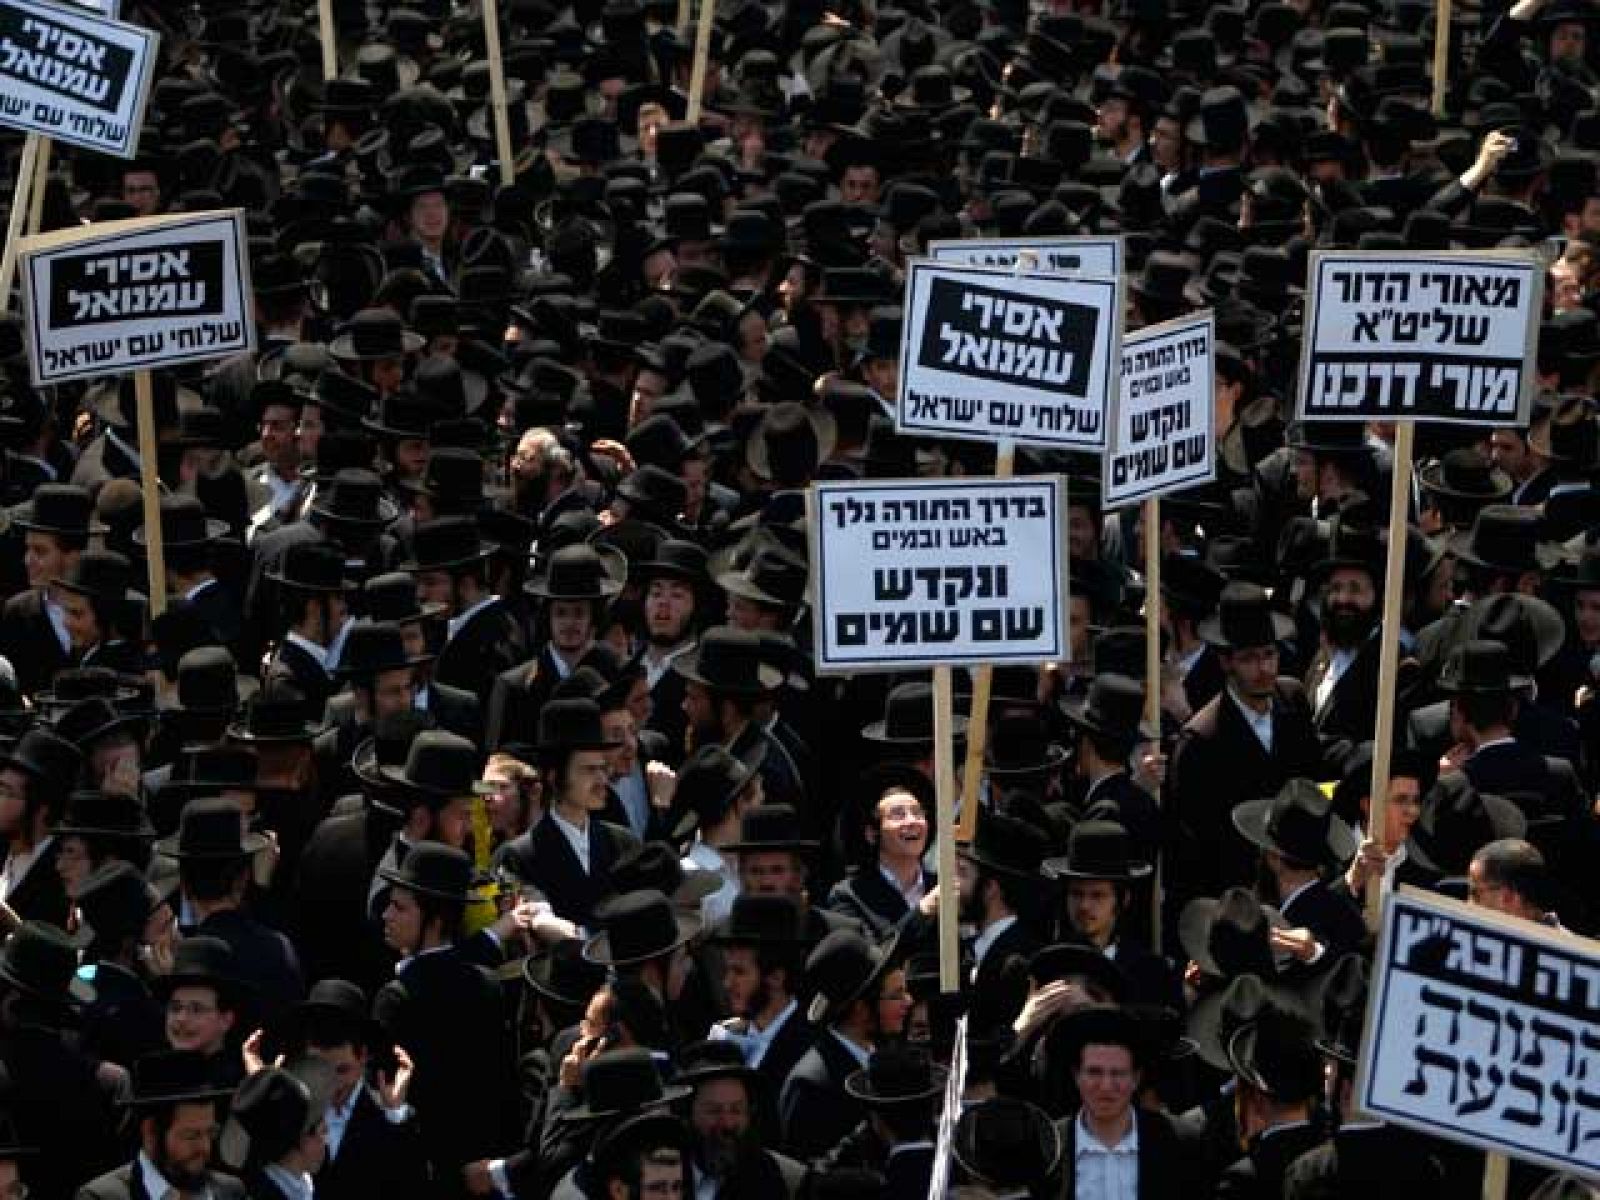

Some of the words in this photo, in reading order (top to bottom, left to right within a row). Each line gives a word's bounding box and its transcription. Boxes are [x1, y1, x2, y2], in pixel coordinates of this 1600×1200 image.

[23, 19, 106, 71] אסירי
[34, 103, 64, 126] עם
[85, 250, 190, 283] אסירי
[68, 280, 206, 321] עמנואל
[1332, 272, 1411, 303] הדור
[1420, 273, 1521, 308] מאורי
[962, 292, 1064, 342] אסירי
[1352, 307, 1490, 345] שליט"א
[128, 332, 163, 355] עם
[170, 321, 241, 349] שלוחי
[1177, 336, 1206, 366] בדרך
[44, 338, 121, 370] ישראל
[940, 322, 1074, 384] עמנואל
[1135, 344, 1175, 373] התורה
[1312, 361, 1421, 407] דרכנו
[1430, 363, 1519, 412] מורי
[909, 390, 983, 421] ישראל
[989, 401, 1024, 425] עם
[1030, 403, 1100, 433] שלוחי
[1130, 400, 1191, 443] ונקדש
[1112, 445, 1168, 486] שמים
[1172, 434, 1206, 470] שם
[830, 496, 876, 528] נלך
[882, 498, 971, 522] התורה
[977, 497, 1046, 524] בדרך
[873, 529, 941, 550] ובמים
[950, 527, 1007, 548] באש
[874, 564, 1008, 607] ונקדש
[836, 609, 960, 646] שמים
[971, 606, 1044, 641] שם
